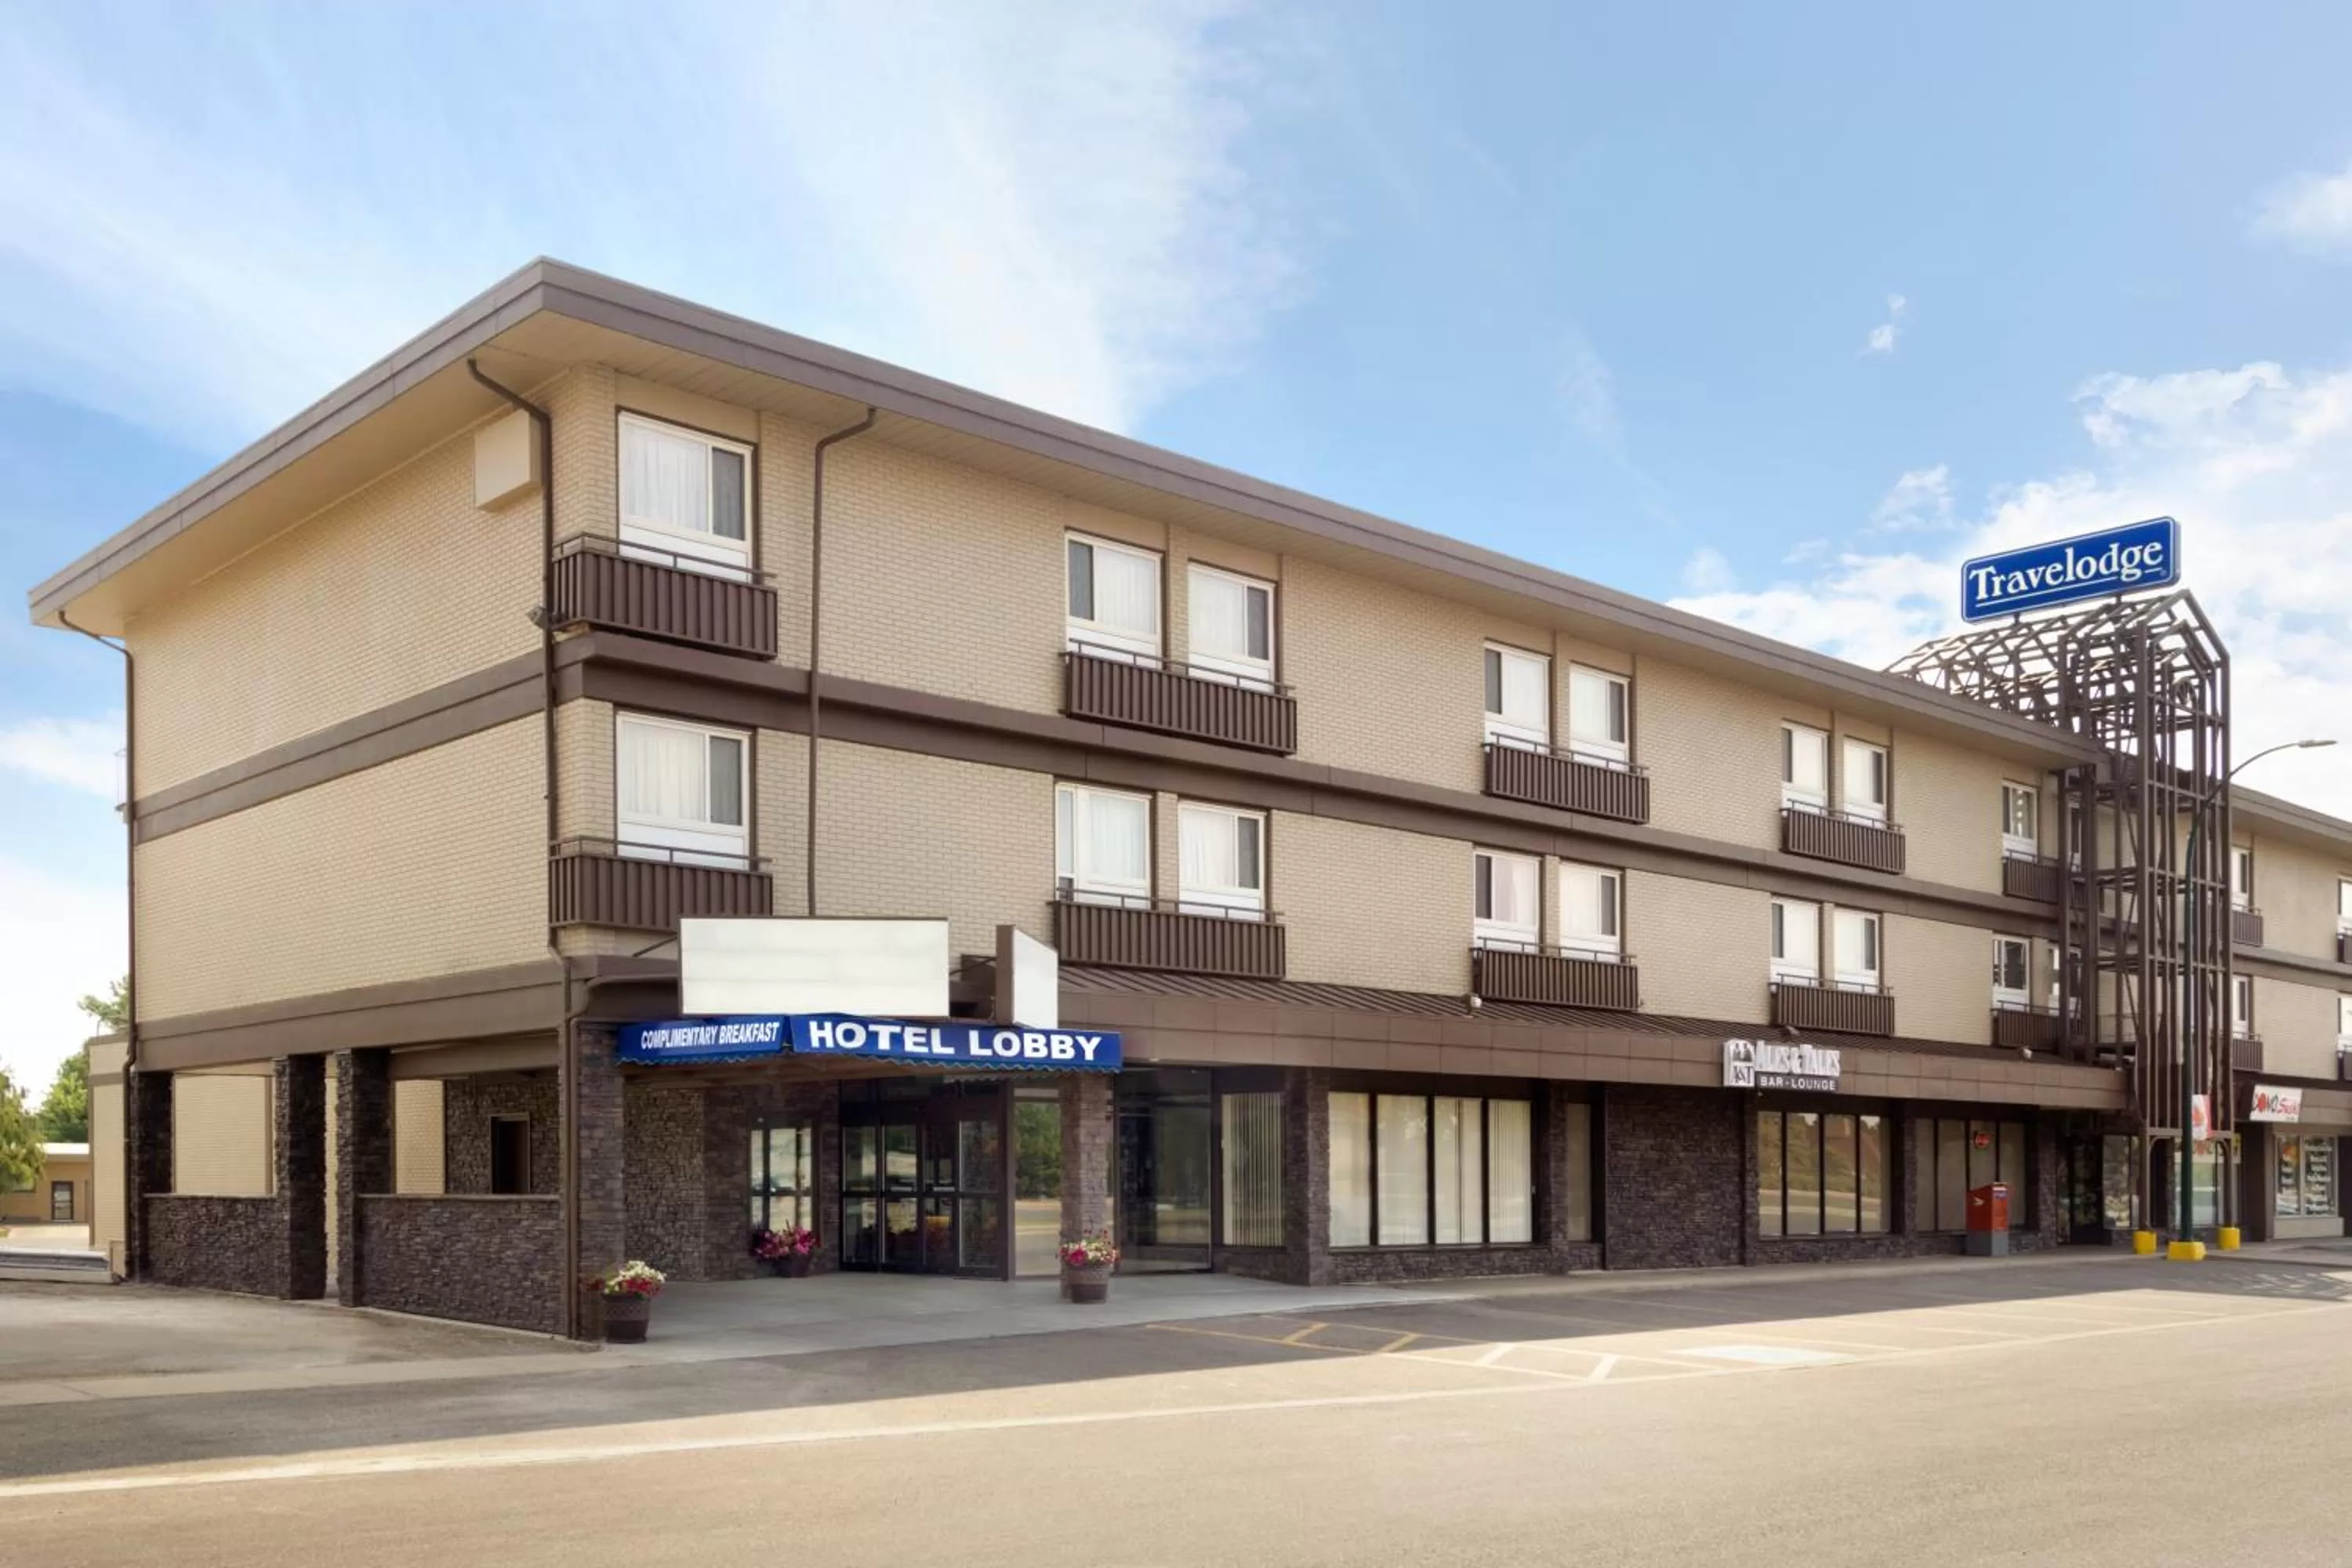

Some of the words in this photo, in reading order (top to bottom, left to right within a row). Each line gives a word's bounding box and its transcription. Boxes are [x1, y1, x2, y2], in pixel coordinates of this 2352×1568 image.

[1969, 542, 2163, 600] Travelodge
[641, 1025, 718, 1050] COMPLIMENTARY
[719, 1022, 780, 1044] BREAKFAST
[809, 1021, 954, 1054] HOTEL
[969, 1029, 1102, 1062] LOBBY
[1791, 1078, 1836, 1091] LOUNGE
